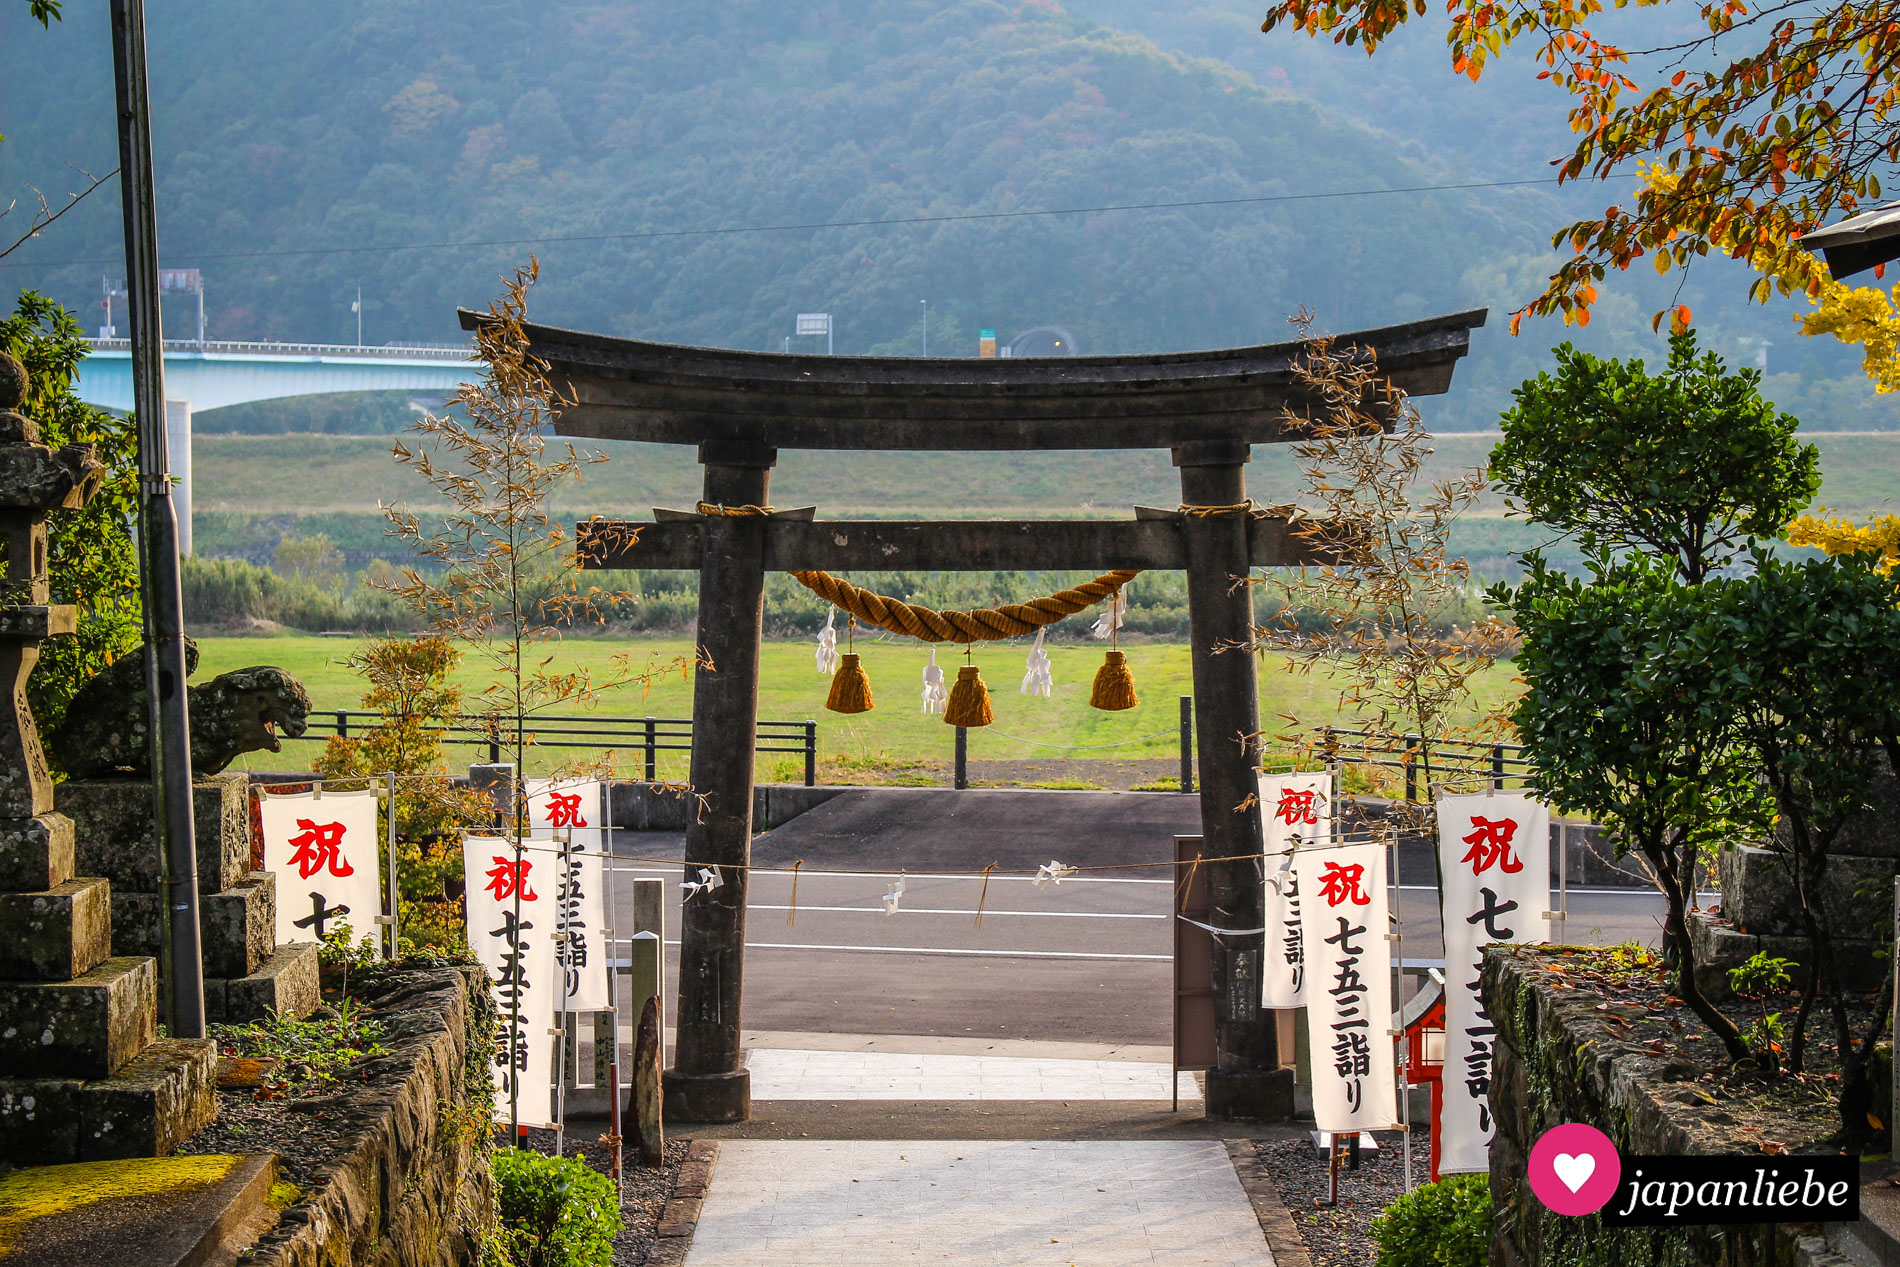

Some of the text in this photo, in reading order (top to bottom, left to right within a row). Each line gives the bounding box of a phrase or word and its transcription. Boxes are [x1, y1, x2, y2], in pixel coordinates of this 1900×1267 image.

[545, 793, 588, 827] 祝
[1276, 788, 1318, 826] 祝
[287, 819, 354, 880] 祝
[1461, 815, 1524, 876] 祝
[484, 856, 538, 901] 祝
[1318, 861, 1371, 1114] 祝 七五三詣り
